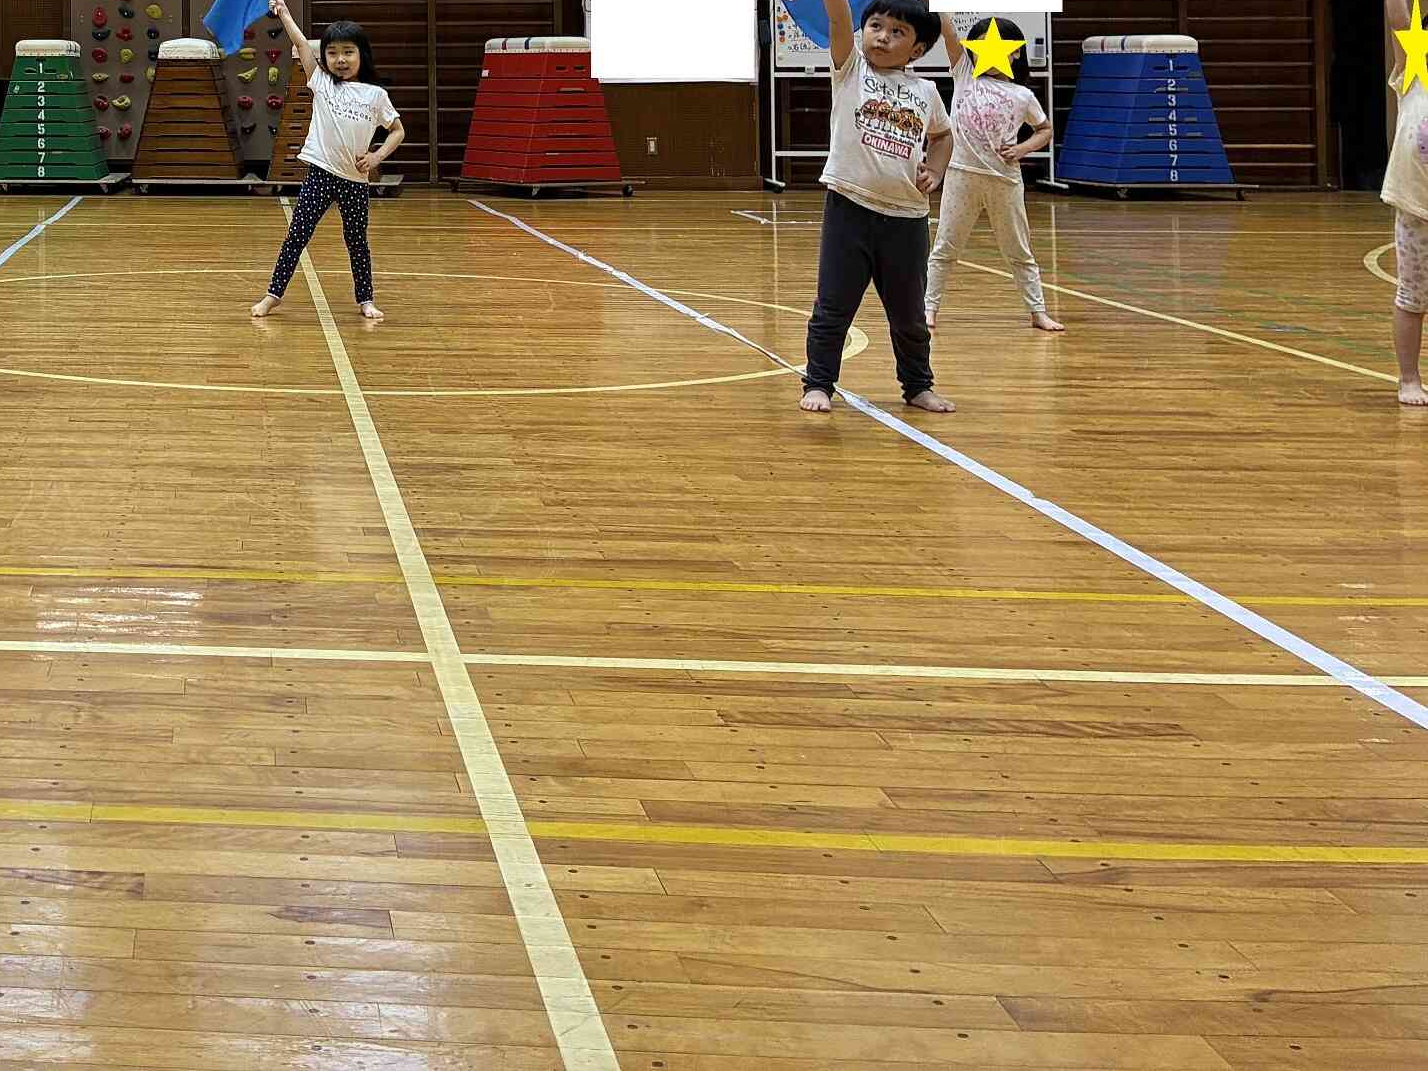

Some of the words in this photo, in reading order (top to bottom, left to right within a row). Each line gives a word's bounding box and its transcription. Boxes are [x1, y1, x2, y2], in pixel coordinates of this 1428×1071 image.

[37, 81, 45, 92] 2
[1167, 79, 1176, 91] 2
[37, 96, 45, 107] 3
[1167, 94, 1176, 106] 3
[37, 110, 45, 121] 4
[1168, 110, 1176, 121] 4
[37, 123, 45, 135] 5
[1168, 124, 1177, 136] 5
[37, 138, 45, 149] 6
[864, 135, 909, 157] OKINAWA
[1169, 139, 1177, 151] 6
[37, 152, 45, 163] 7
[1169, 154, 1178, 166] 7
[37, 166, 45, 177] 8
[1170, 169, 1178, 181] 8
